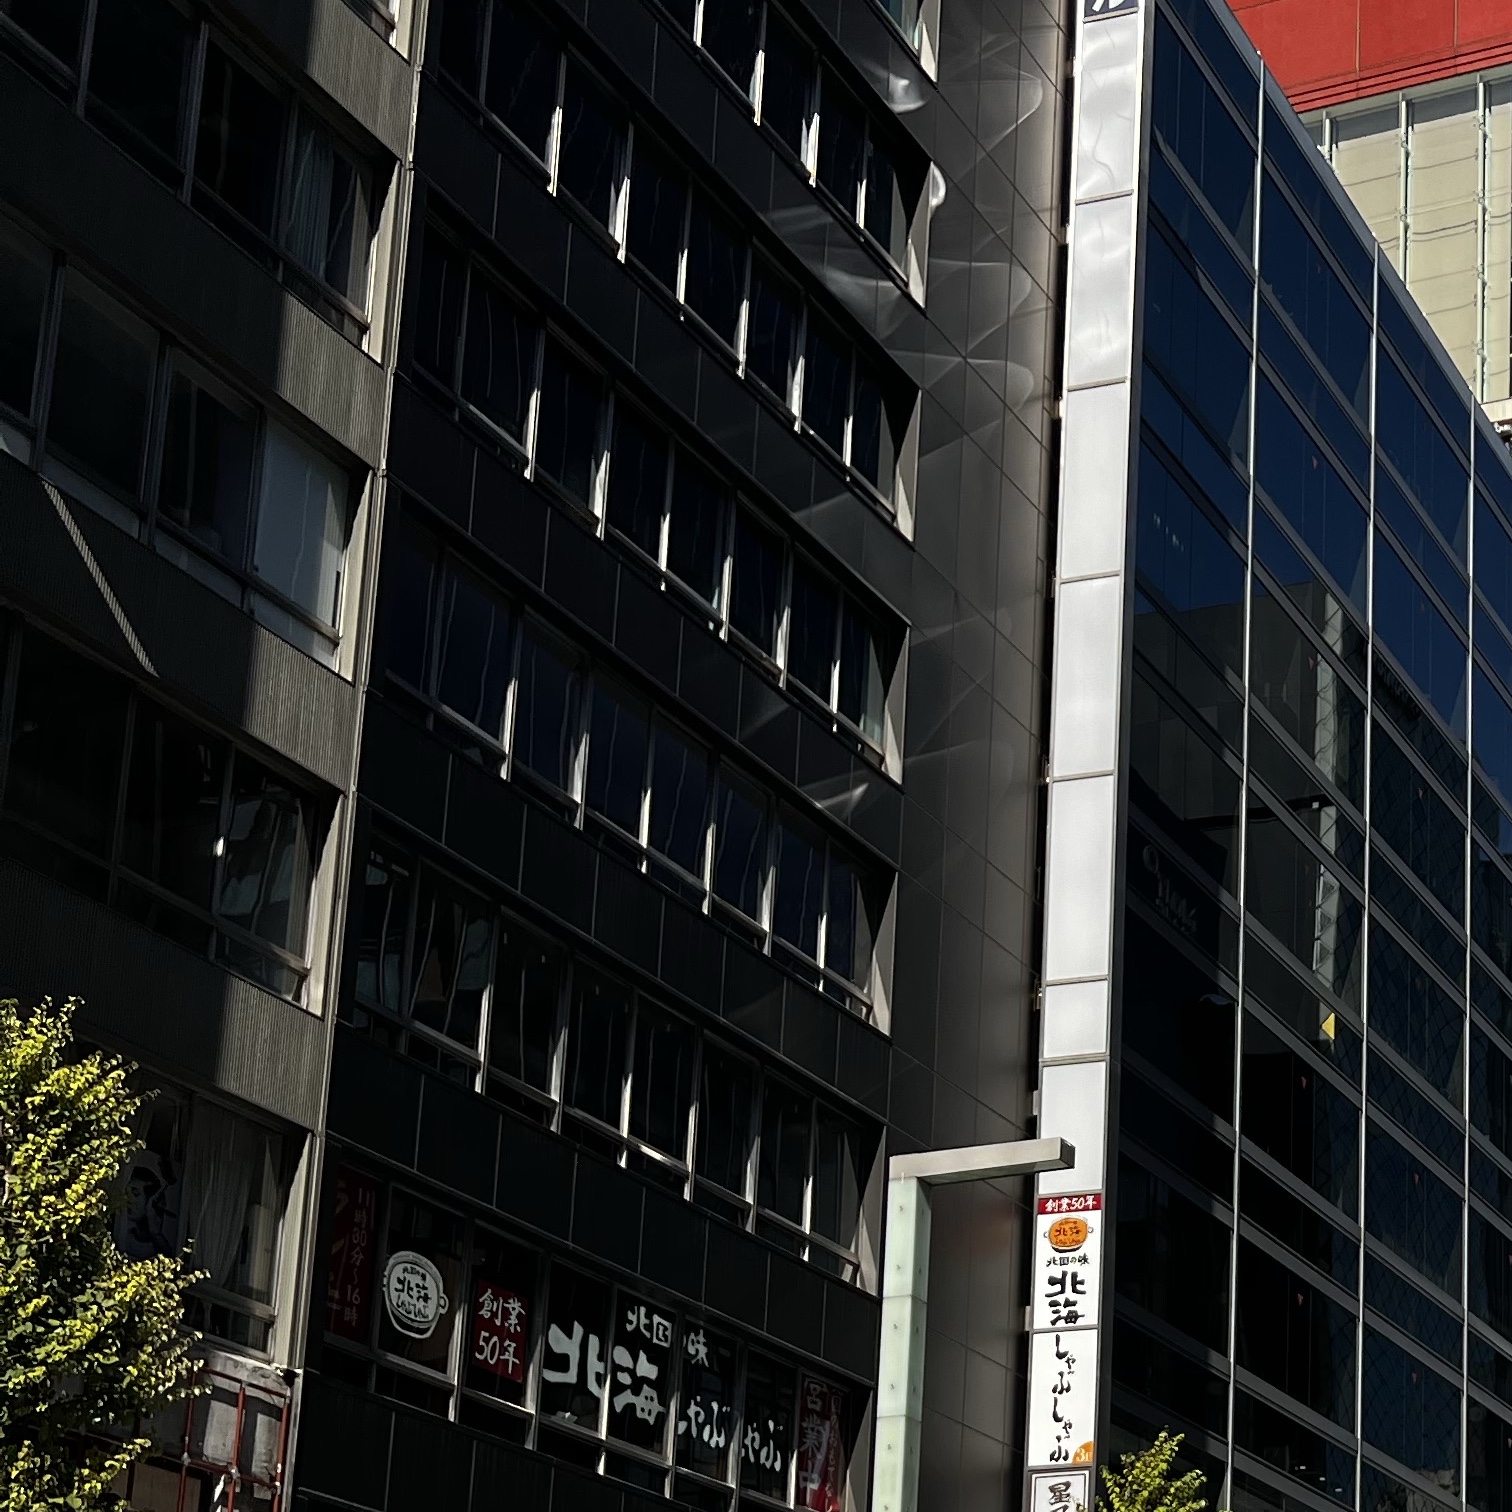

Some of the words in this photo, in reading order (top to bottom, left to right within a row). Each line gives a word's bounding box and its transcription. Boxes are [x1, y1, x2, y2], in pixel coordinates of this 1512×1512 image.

[1044, 1195, 1097, 1213] 創業50年
[1046, 1253, 1090, 1267] 北国の味
[478, 1288, 526, 1333] 創業
[1045, 1270, 1087, 1326] 北海
[474, 1330, 520, 1374] 50年
[626, 1305, 710, 1368] 北国味
[542, 1320, 666, 1426] 北海
[1049, 1334, 1076, 1462] しゃぶしゃぶ
